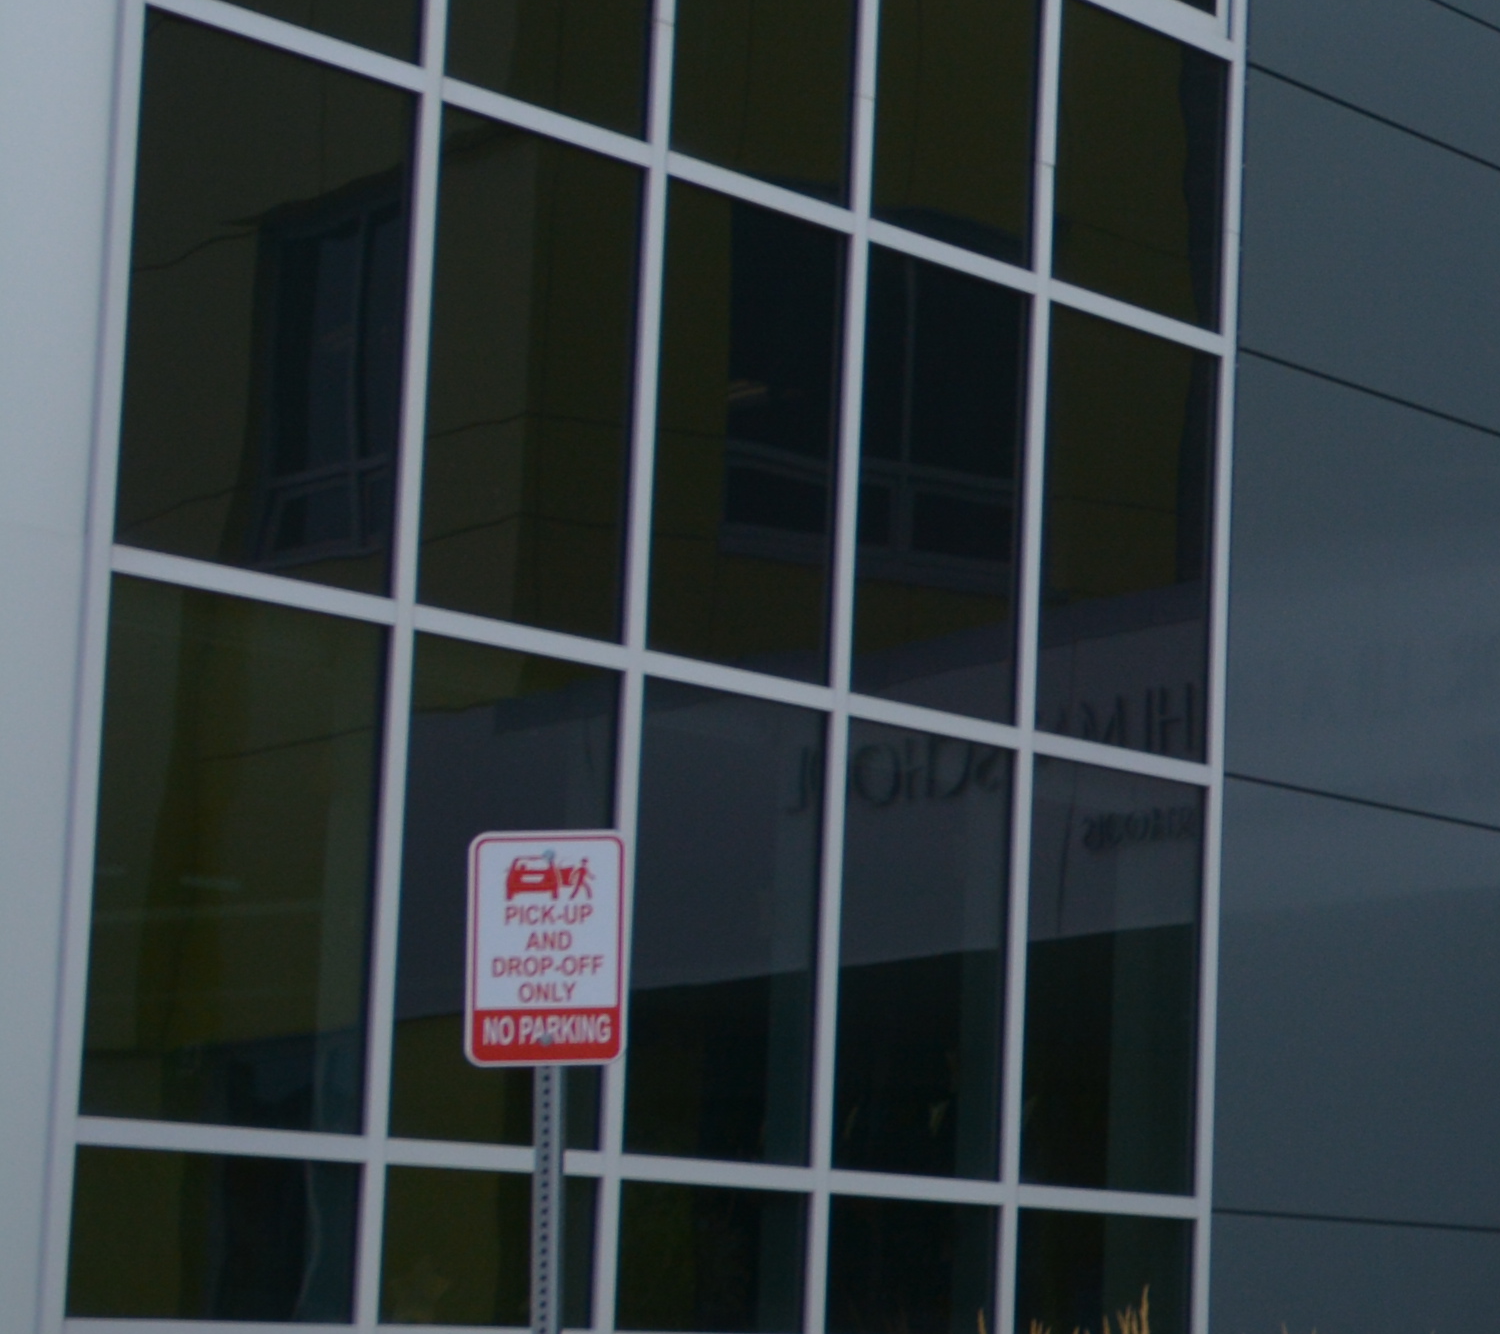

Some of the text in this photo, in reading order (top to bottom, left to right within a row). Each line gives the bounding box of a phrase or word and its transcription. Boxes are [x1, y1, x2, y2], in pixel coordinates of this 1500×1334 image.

[505, 905, 594, 925] PICK-UP
[527, 931, 572, 950] AND
[492, 956, 603, 977] DROP-OFF
[519, 983, 575, 1002] ONLY
[483, 1015, 611, 1045] NO PARKING
